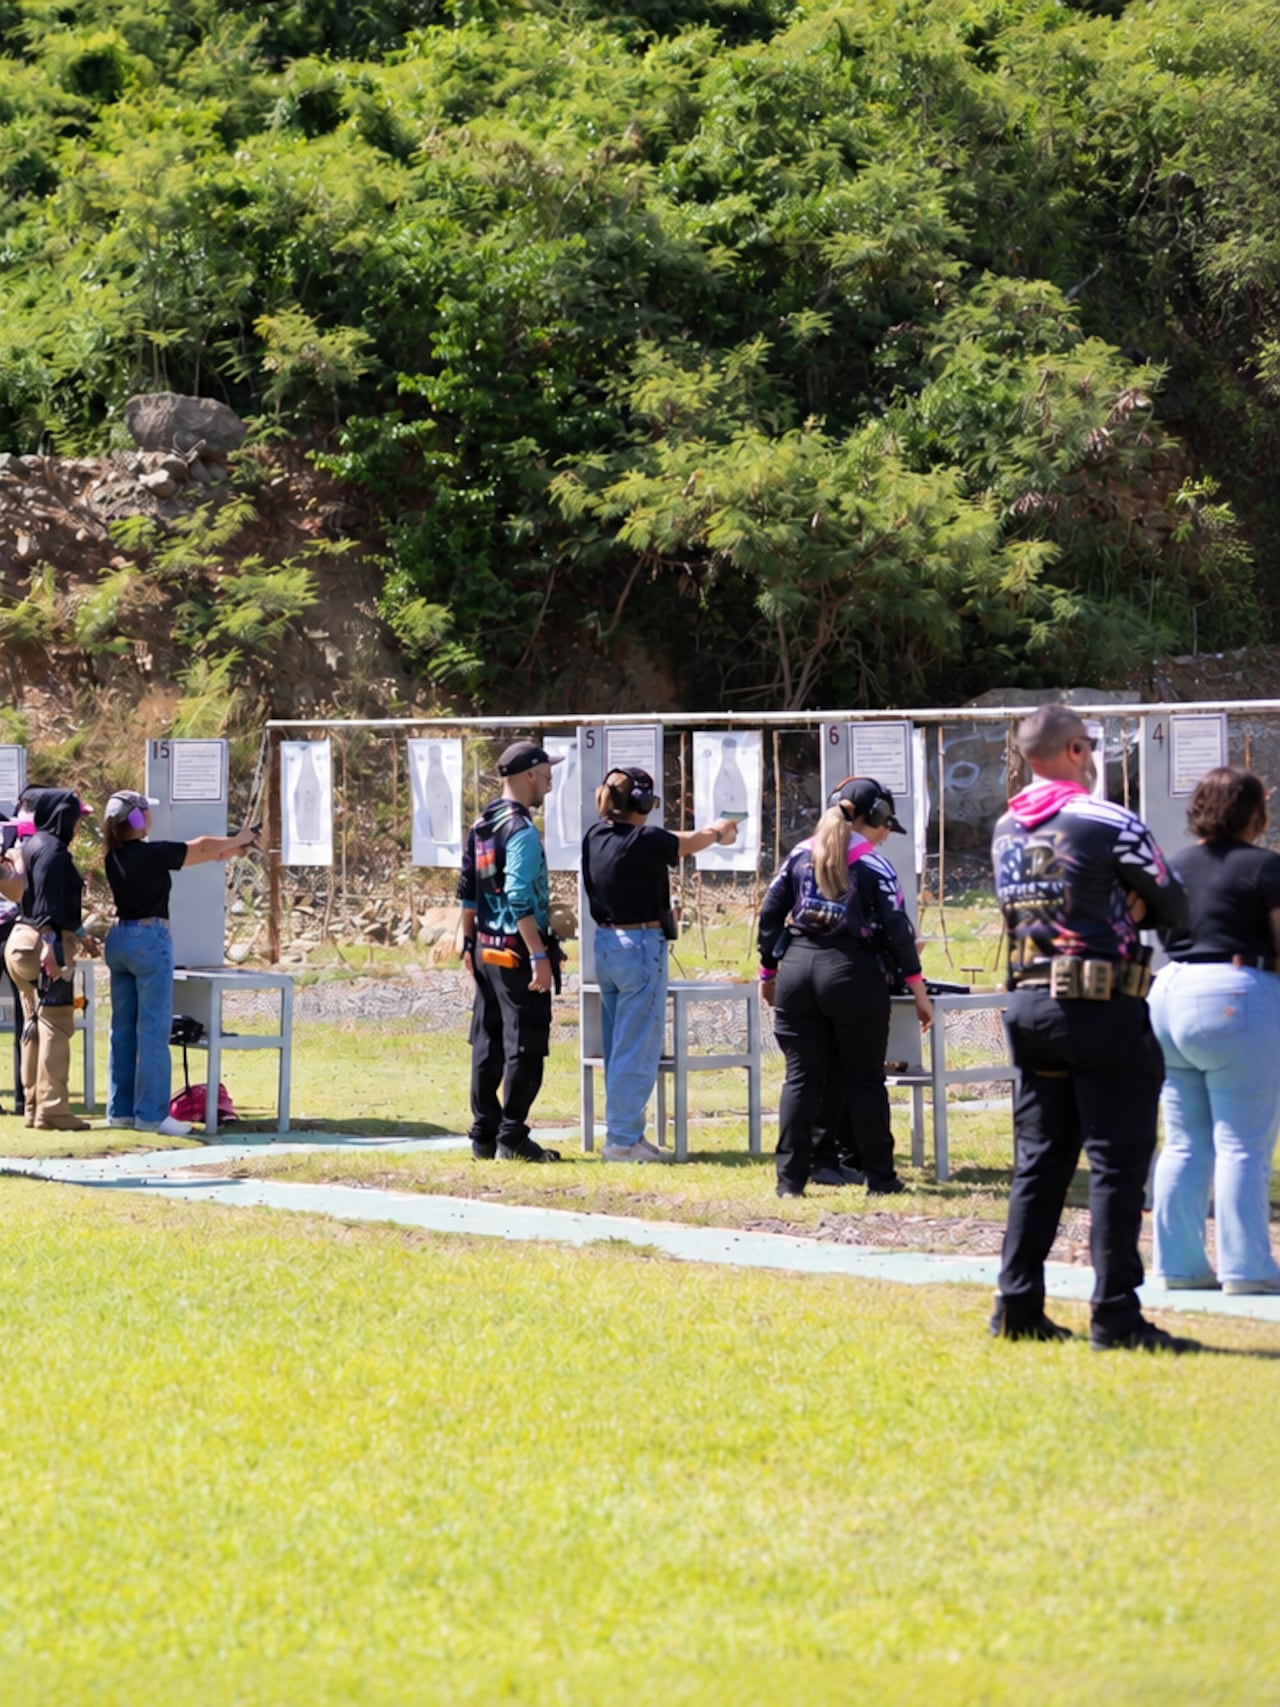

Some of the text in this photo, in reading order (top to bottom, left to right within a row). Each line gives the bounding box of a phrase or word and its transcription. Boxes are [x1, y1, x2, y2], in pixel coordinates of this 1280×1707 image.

[585, 730, 595, 749] 5
[829, 725, 839, 746] 6
[1152, 722, 1165, 749] 4
[153, 741, 170, 760] 15
